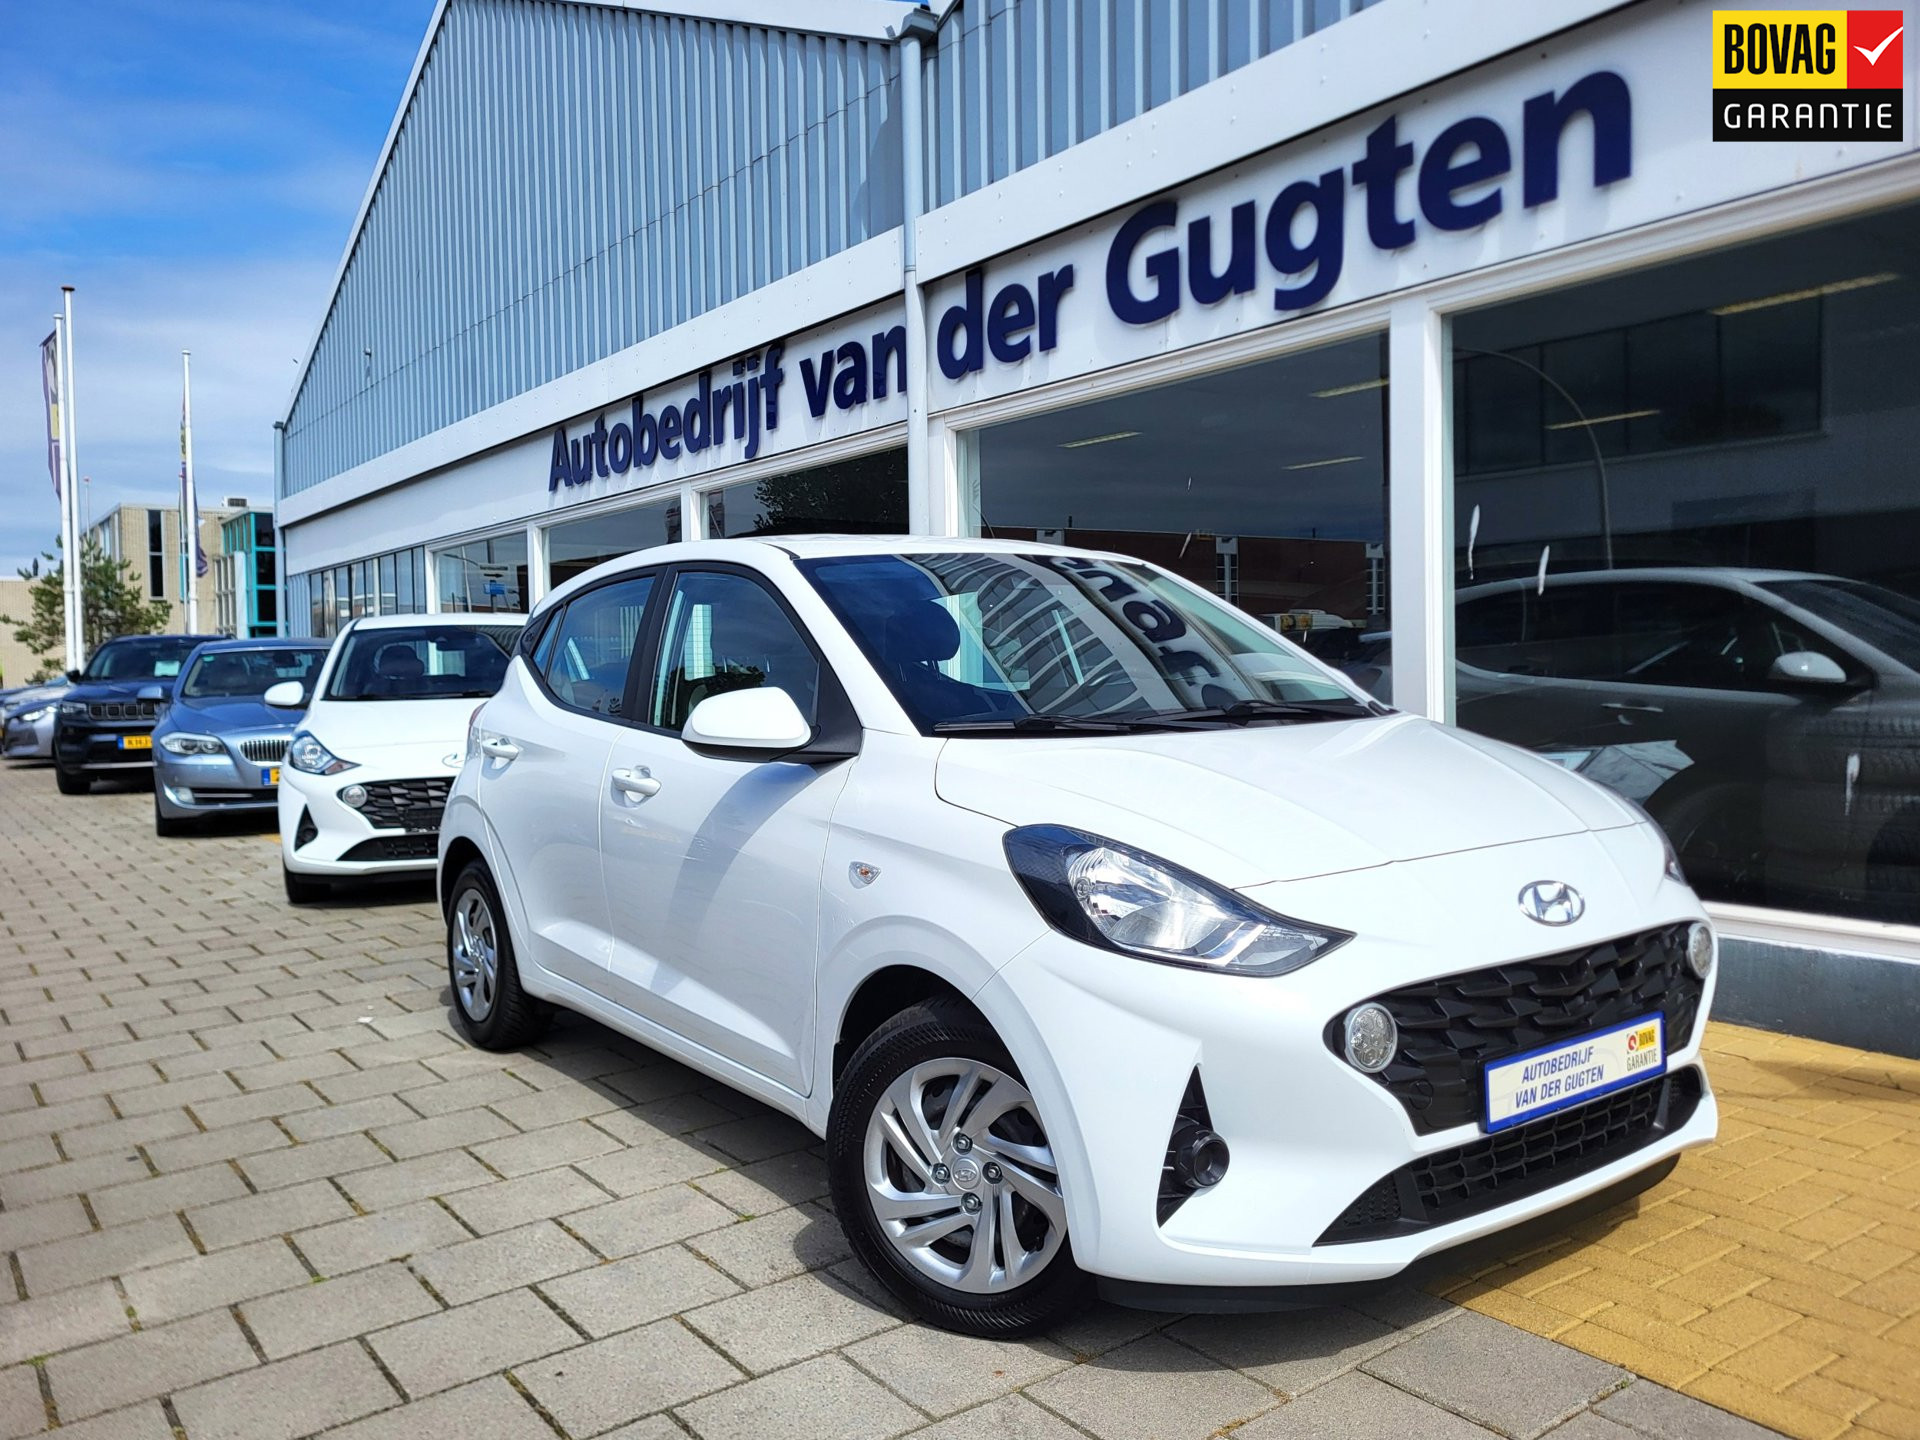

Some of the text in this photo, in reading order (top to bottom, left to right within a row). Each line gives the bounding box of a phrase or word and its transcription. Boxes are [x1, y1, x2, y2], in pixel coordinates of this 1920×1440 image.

[548, 70, 1633, 492] Autobedrijf van der Gugten
[1521, 1046, 1594, 1084] AUTOBEDRIJF
[1626, 1048, 1657, 1072] GARANTIE
[1515, 1064, 1604, 1109] VAN DER GUGTEN
